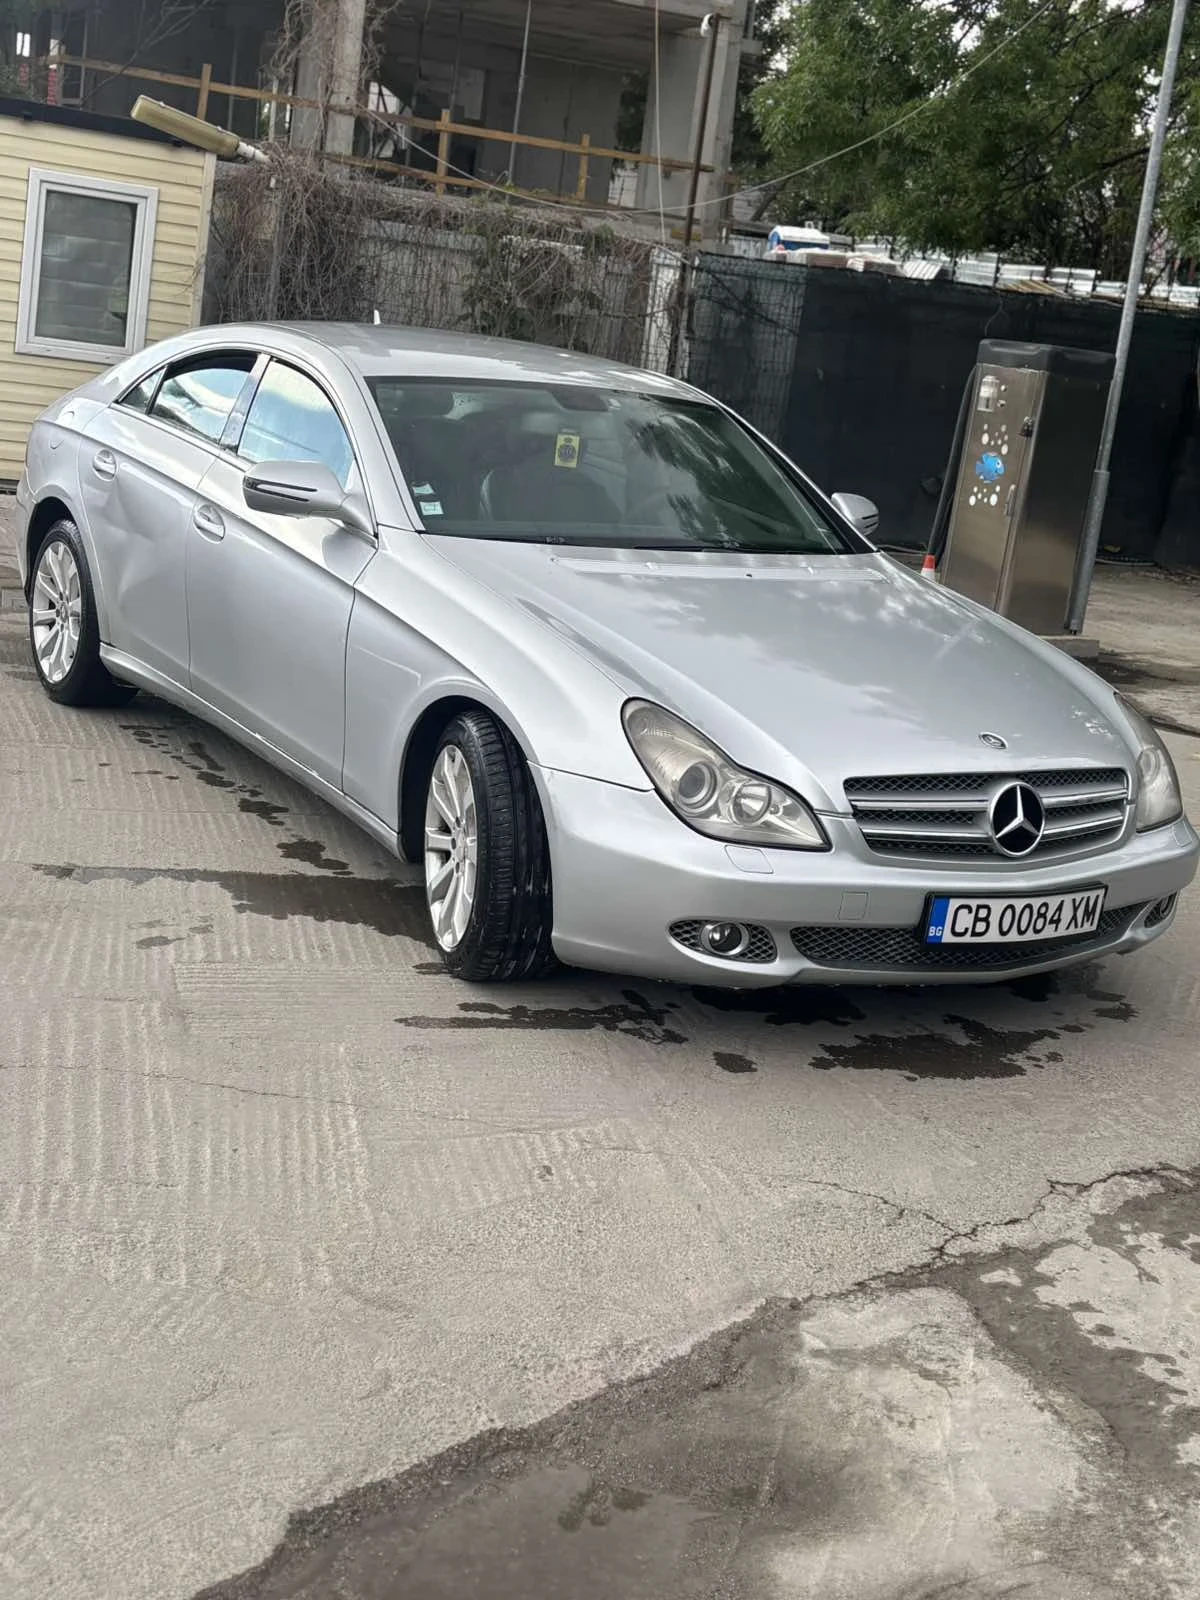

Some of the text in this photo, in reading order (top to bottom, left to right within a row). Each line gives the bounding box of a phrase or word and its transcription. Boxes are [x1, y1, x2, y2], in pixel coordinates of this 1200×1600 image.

[950, 894, 1100, 937] CB 0084 XM
[928, 926, 943, 936] BG
